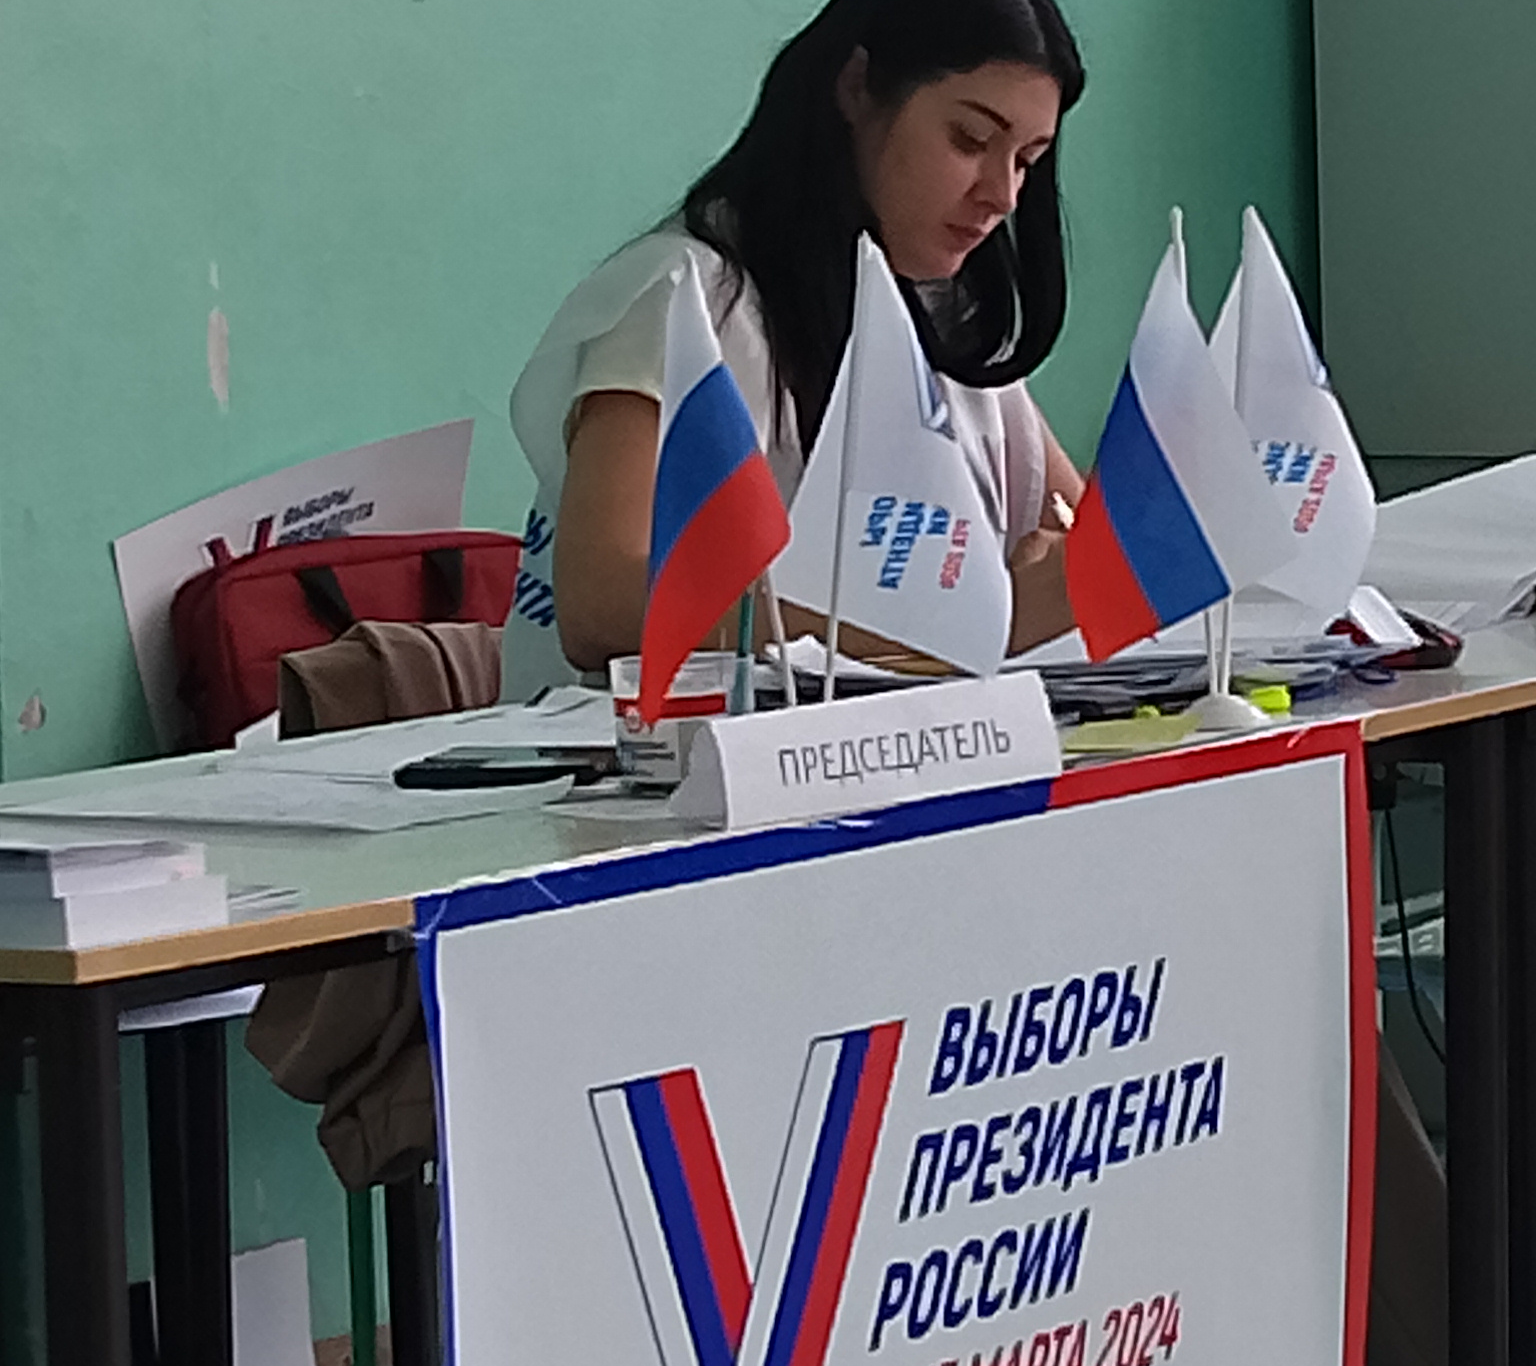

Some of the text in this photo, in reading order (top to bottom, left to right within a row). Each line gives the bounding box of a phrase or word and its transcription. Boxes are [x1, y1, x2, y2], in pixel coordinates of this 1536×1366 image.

[778, 718, 1011, 785] ПРЕДСЕДАТЕЛЬ
[927, 957, 1167, 1096] ВЫБОРЫ
[898, 1056, 1225, 1223] ПРЕЗИДЕНТА
[868, 1207, 1090, 1353] РОССИИ
